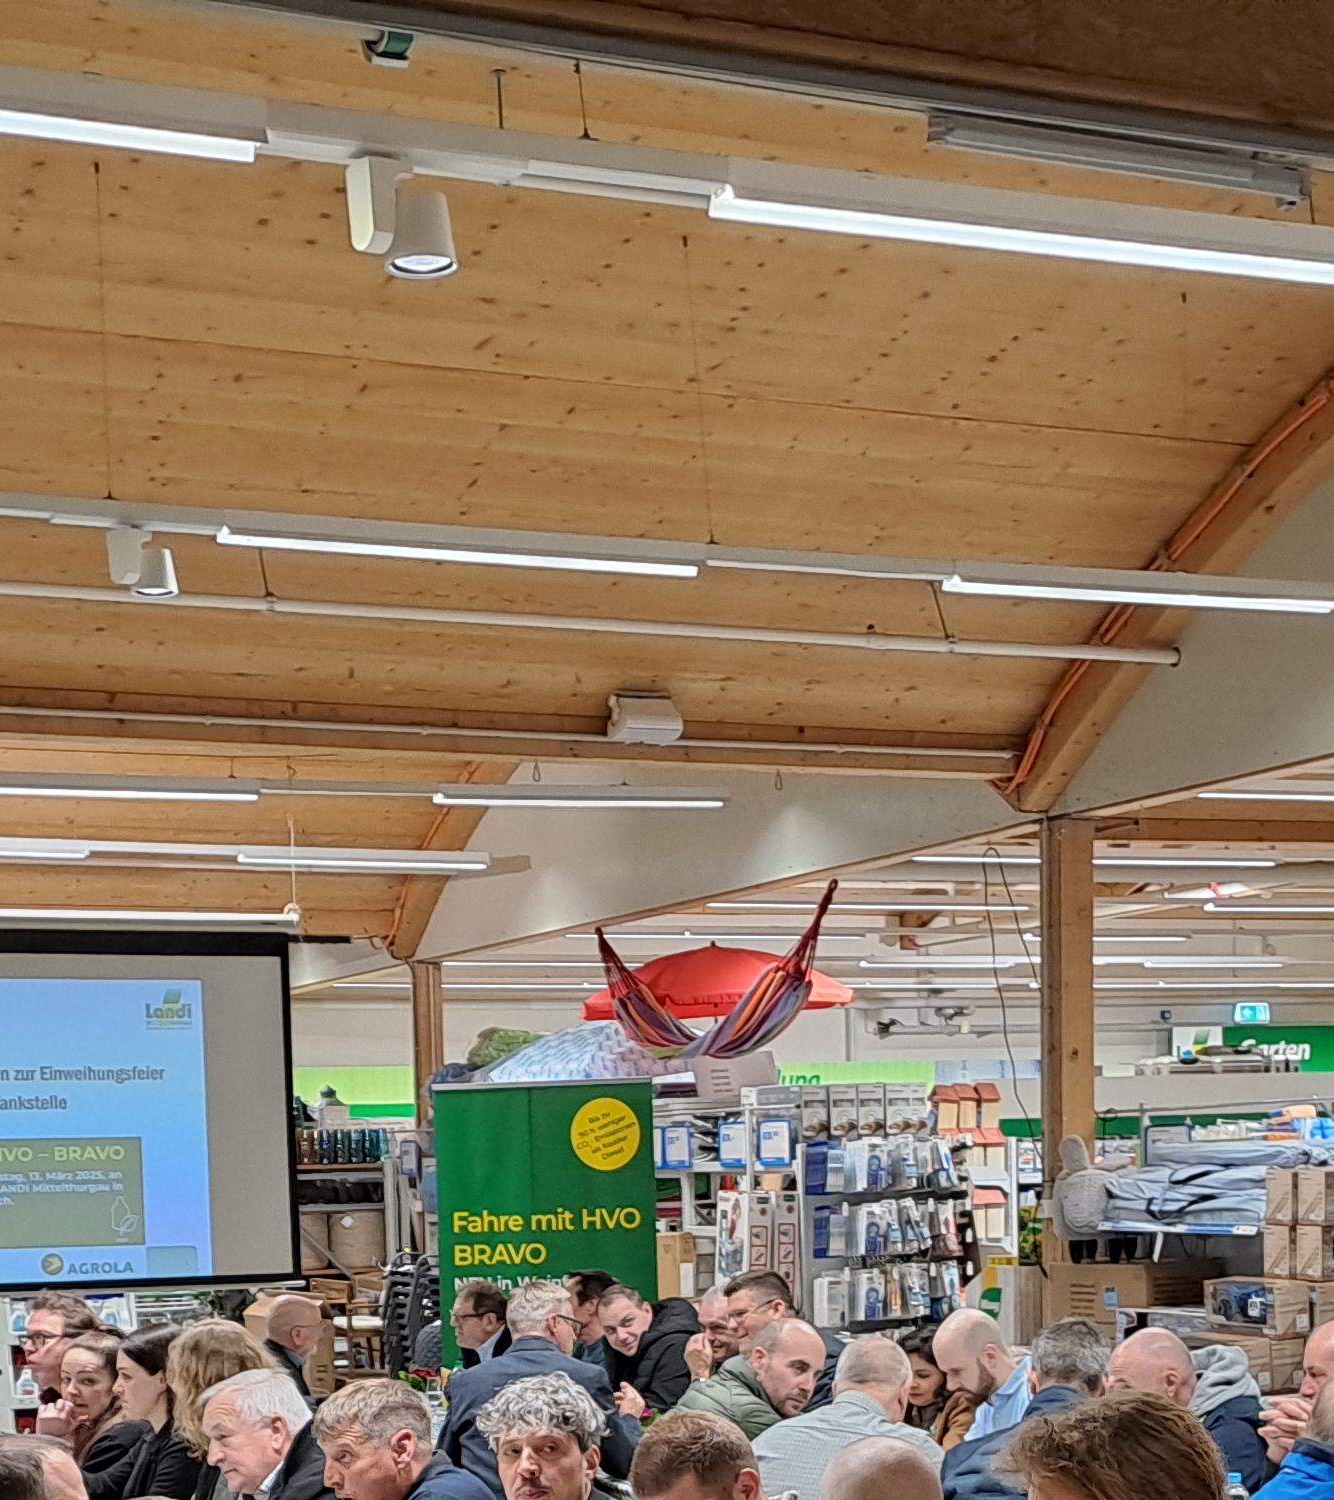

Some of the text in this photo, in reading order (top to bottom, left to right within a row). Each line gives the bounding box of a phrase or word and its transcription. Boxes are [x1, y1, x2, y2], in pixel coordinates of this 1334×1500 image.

[144, 1003, 193, 1019] Landi
[13, 1069, 37, 1081] zur
[39, 1065, 166, 1084] Einweihungsfeier
[53, 1145, 125, 1161] BRAVO
[453, 1207, 642, 1234] Fahre mit HVO
[453, 1243, 548, 1266] BRAVO
[67, 1261, 134, 1275] AGROLA
